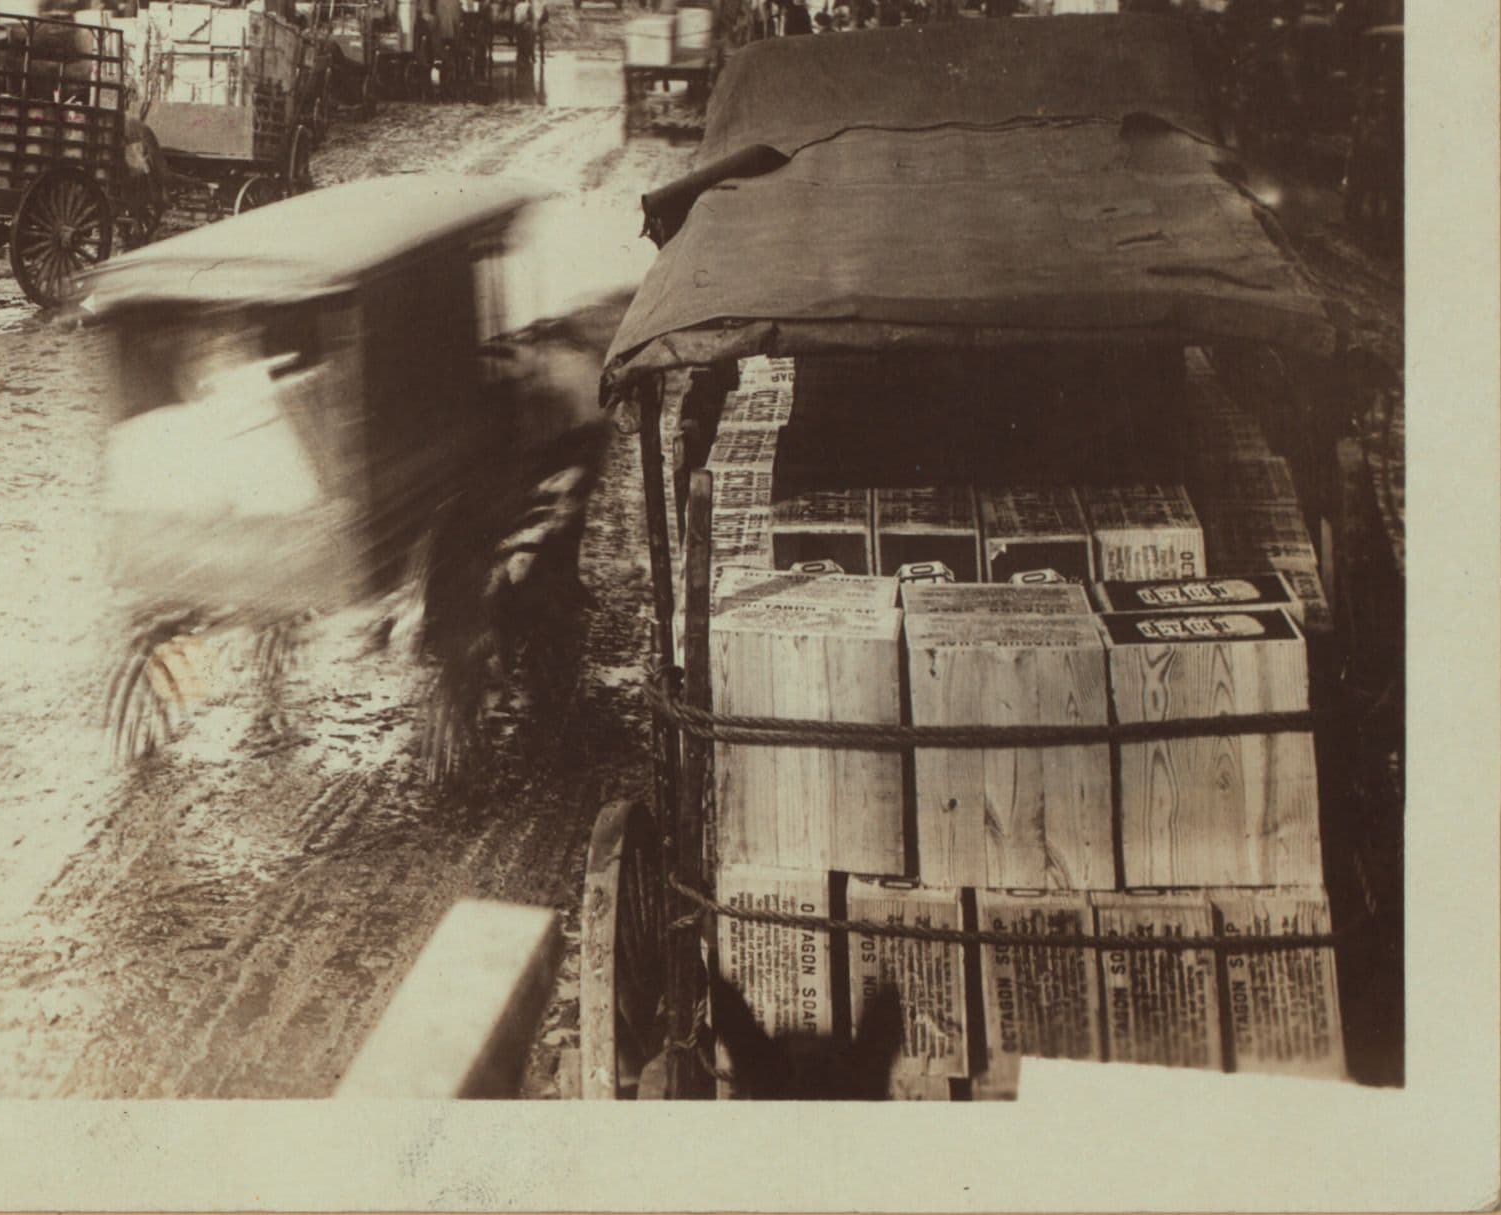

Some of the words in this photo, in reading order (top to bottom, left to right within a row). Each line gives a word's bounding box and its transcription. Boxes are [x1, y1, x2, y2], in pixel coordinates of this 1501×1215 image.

[801, 902, 816, 976] OTAGON
[993, 918, 1010, 965] SOP
[1108, 929, 1126, 975] SO
[1225, 922, 1244, 969] SP
[995, 977, 1017, 1053] OCTAGON
